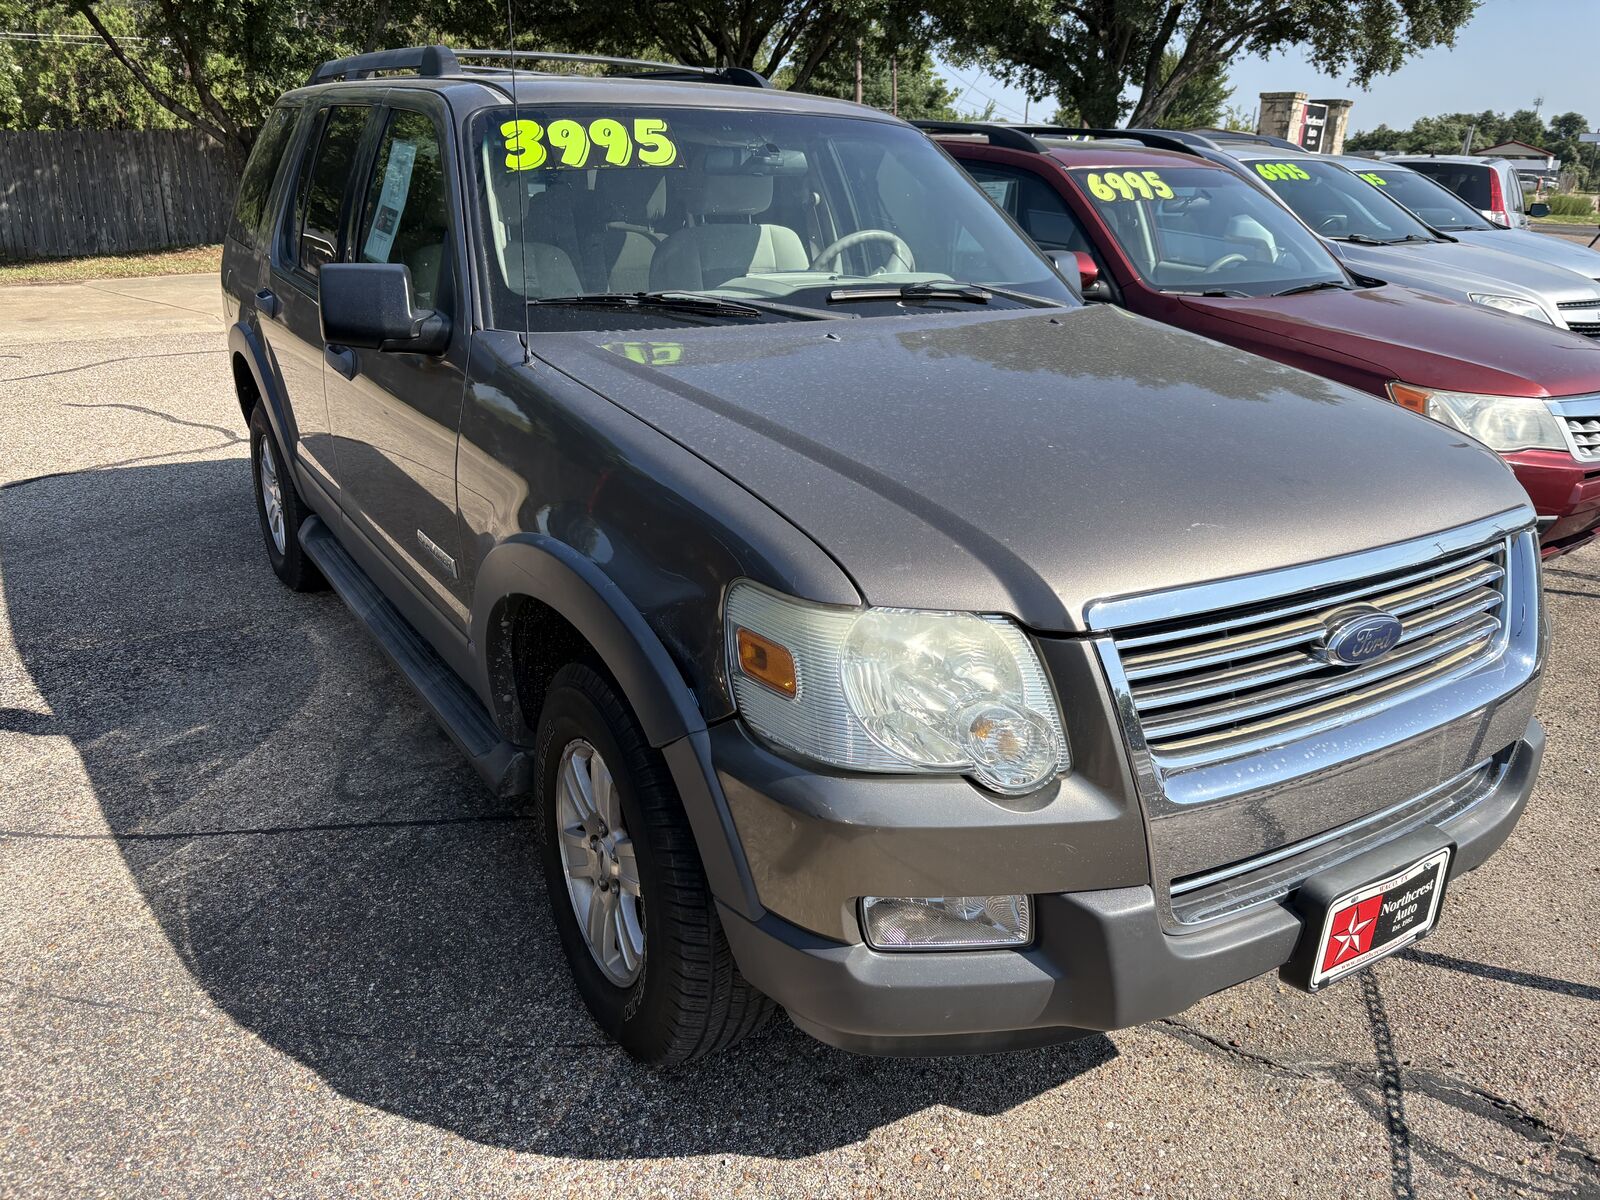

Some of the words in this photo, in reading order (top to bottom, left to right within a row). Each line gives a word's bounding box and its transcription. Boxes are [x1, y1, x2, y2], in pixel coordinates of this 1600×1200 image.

[500, 118, 677, 171] 3995
[1087, 171, 1174, 201] 6995
[1255, 163, 1310, 181] 6995
[1352, 625, 1393, 657] Ford
[1380, 878, 1434, 917] Northcrest
[1392, 903, 1418, 923] Auto
